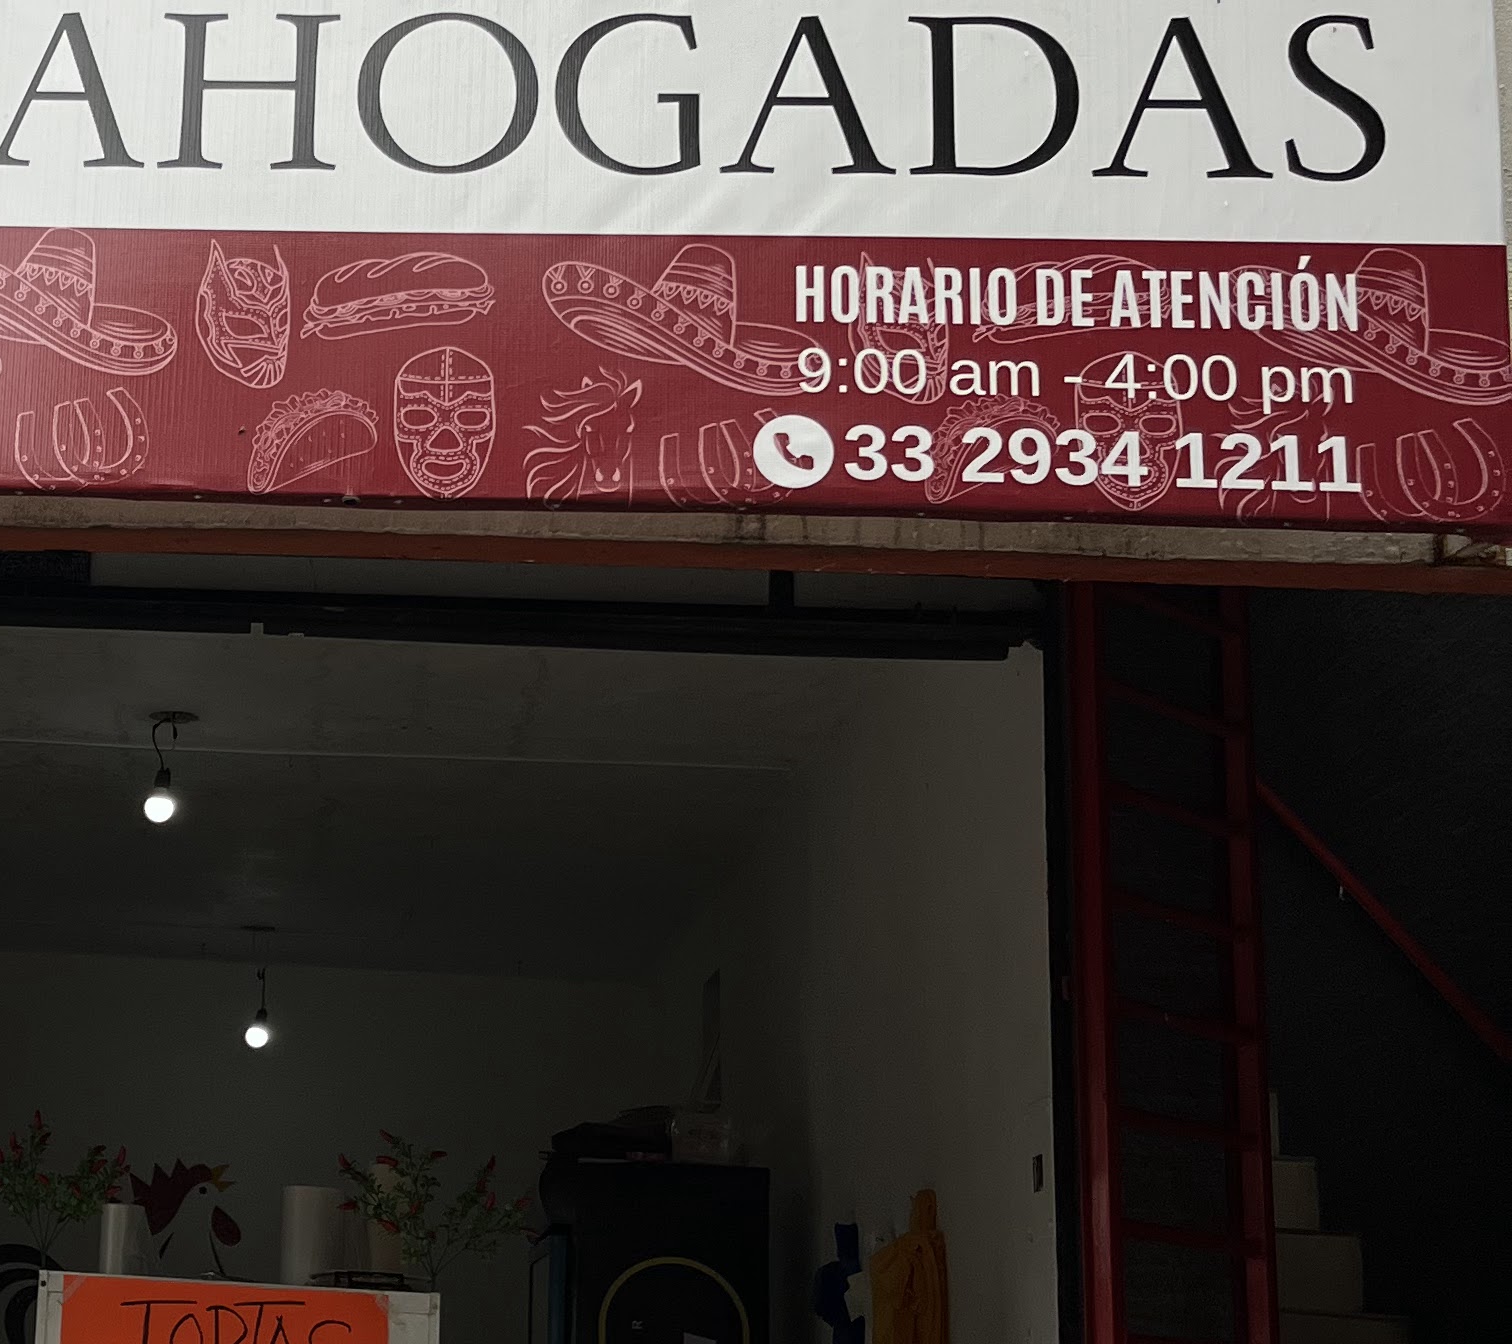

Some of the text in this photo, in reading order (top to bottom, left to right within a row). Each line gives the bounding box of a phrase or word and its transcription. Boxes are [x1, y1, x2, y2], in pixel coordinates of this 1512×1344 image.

[795, 255, 1360, 333] HORARIO DE ATENCIÓN
[795, 347, 927, 397] 9:00
[949, 359, 1040, 397] am
[1104, 353, 1237, 402] 4:00
[1261, 366, 1353, 415] pm
[844, 424, 1362, 493] 33 2934 1211
